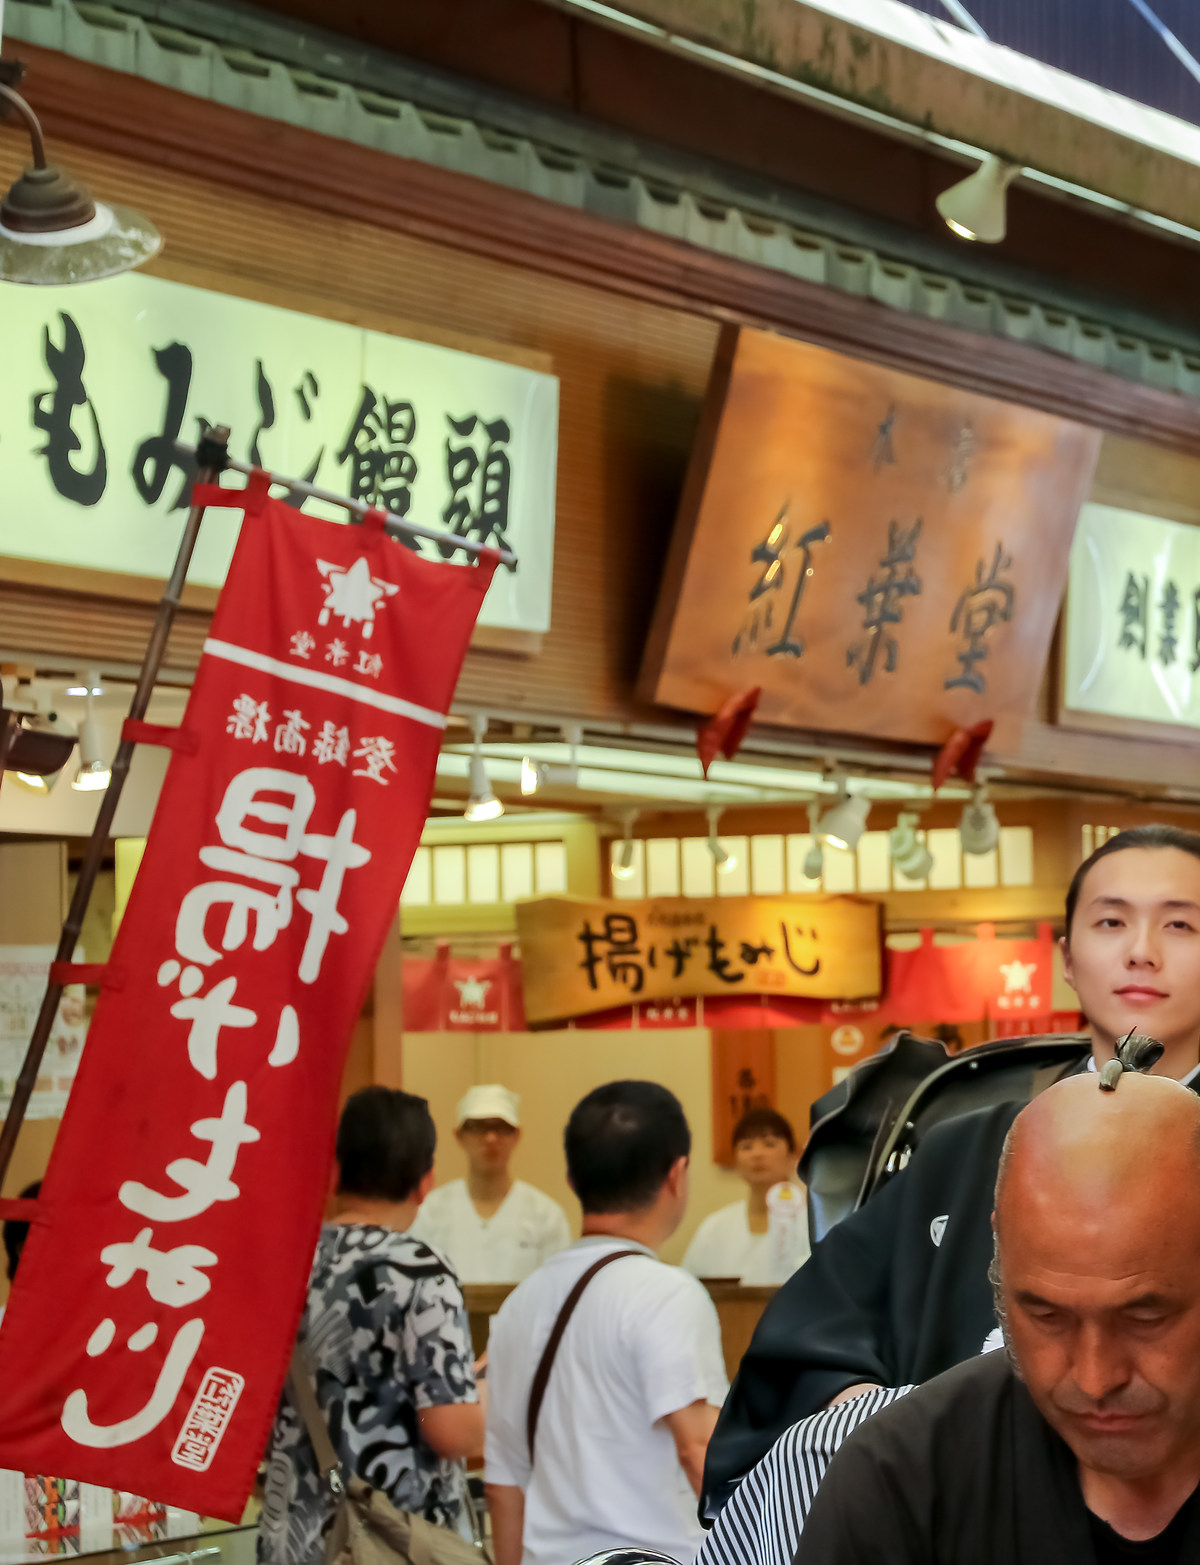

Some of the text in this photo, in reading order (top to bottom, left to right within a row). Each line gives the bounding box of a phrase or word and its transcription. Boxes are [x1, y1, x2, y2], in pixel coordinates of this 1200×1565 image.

[32, 310, 514, 566] もみじ饅頭
[731, 493, 1014, 694] 紅葉堂
[578, 913, 820, 992] 揚げもみじ
